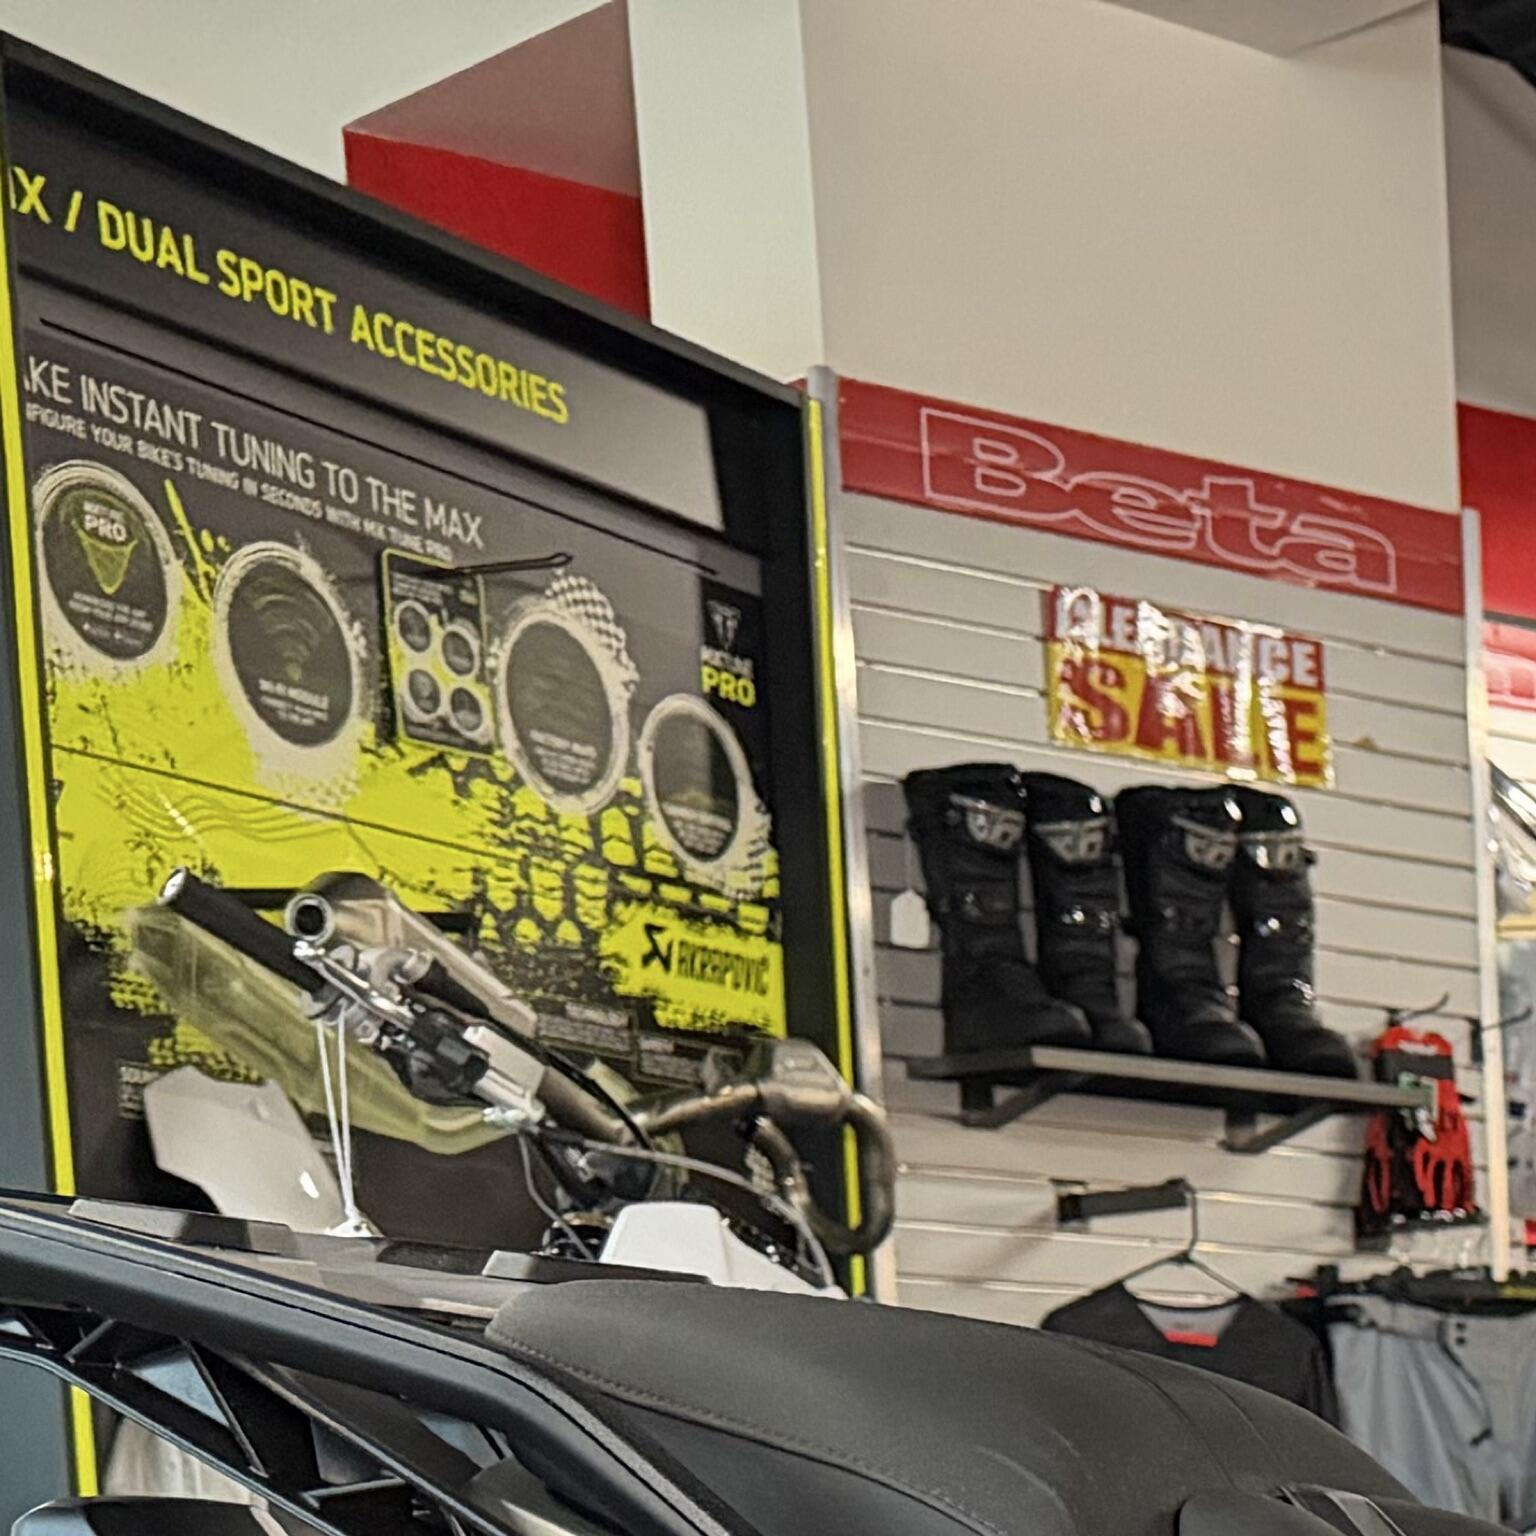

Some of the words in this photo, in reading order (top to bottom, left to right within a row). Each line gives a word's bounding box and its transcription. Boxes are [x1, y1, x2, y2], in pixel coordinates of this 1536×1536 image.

[8, 164, 52, 225] X
[96, 199, 211, 285] DUAL
[215, 248, 338, 335] SPORT
[350, 304, 570, 425] ACCESSORIES
[79, 373, 203, 451] INSTANT
[210, 420, 317, 491] TUNING
[320, 461, 360, 505] TO
[364, 475, 419, 527] THE
[423, 495, 485, 550] MAX
[89, 422, 135, 456] YOUR
[921, 406, 1399, 594] Beta
[700, 664, 757, 708] PRO
[1055, 587, 1320, 688] CLEANCE
[1058, 656, 1321, 778] SALE
